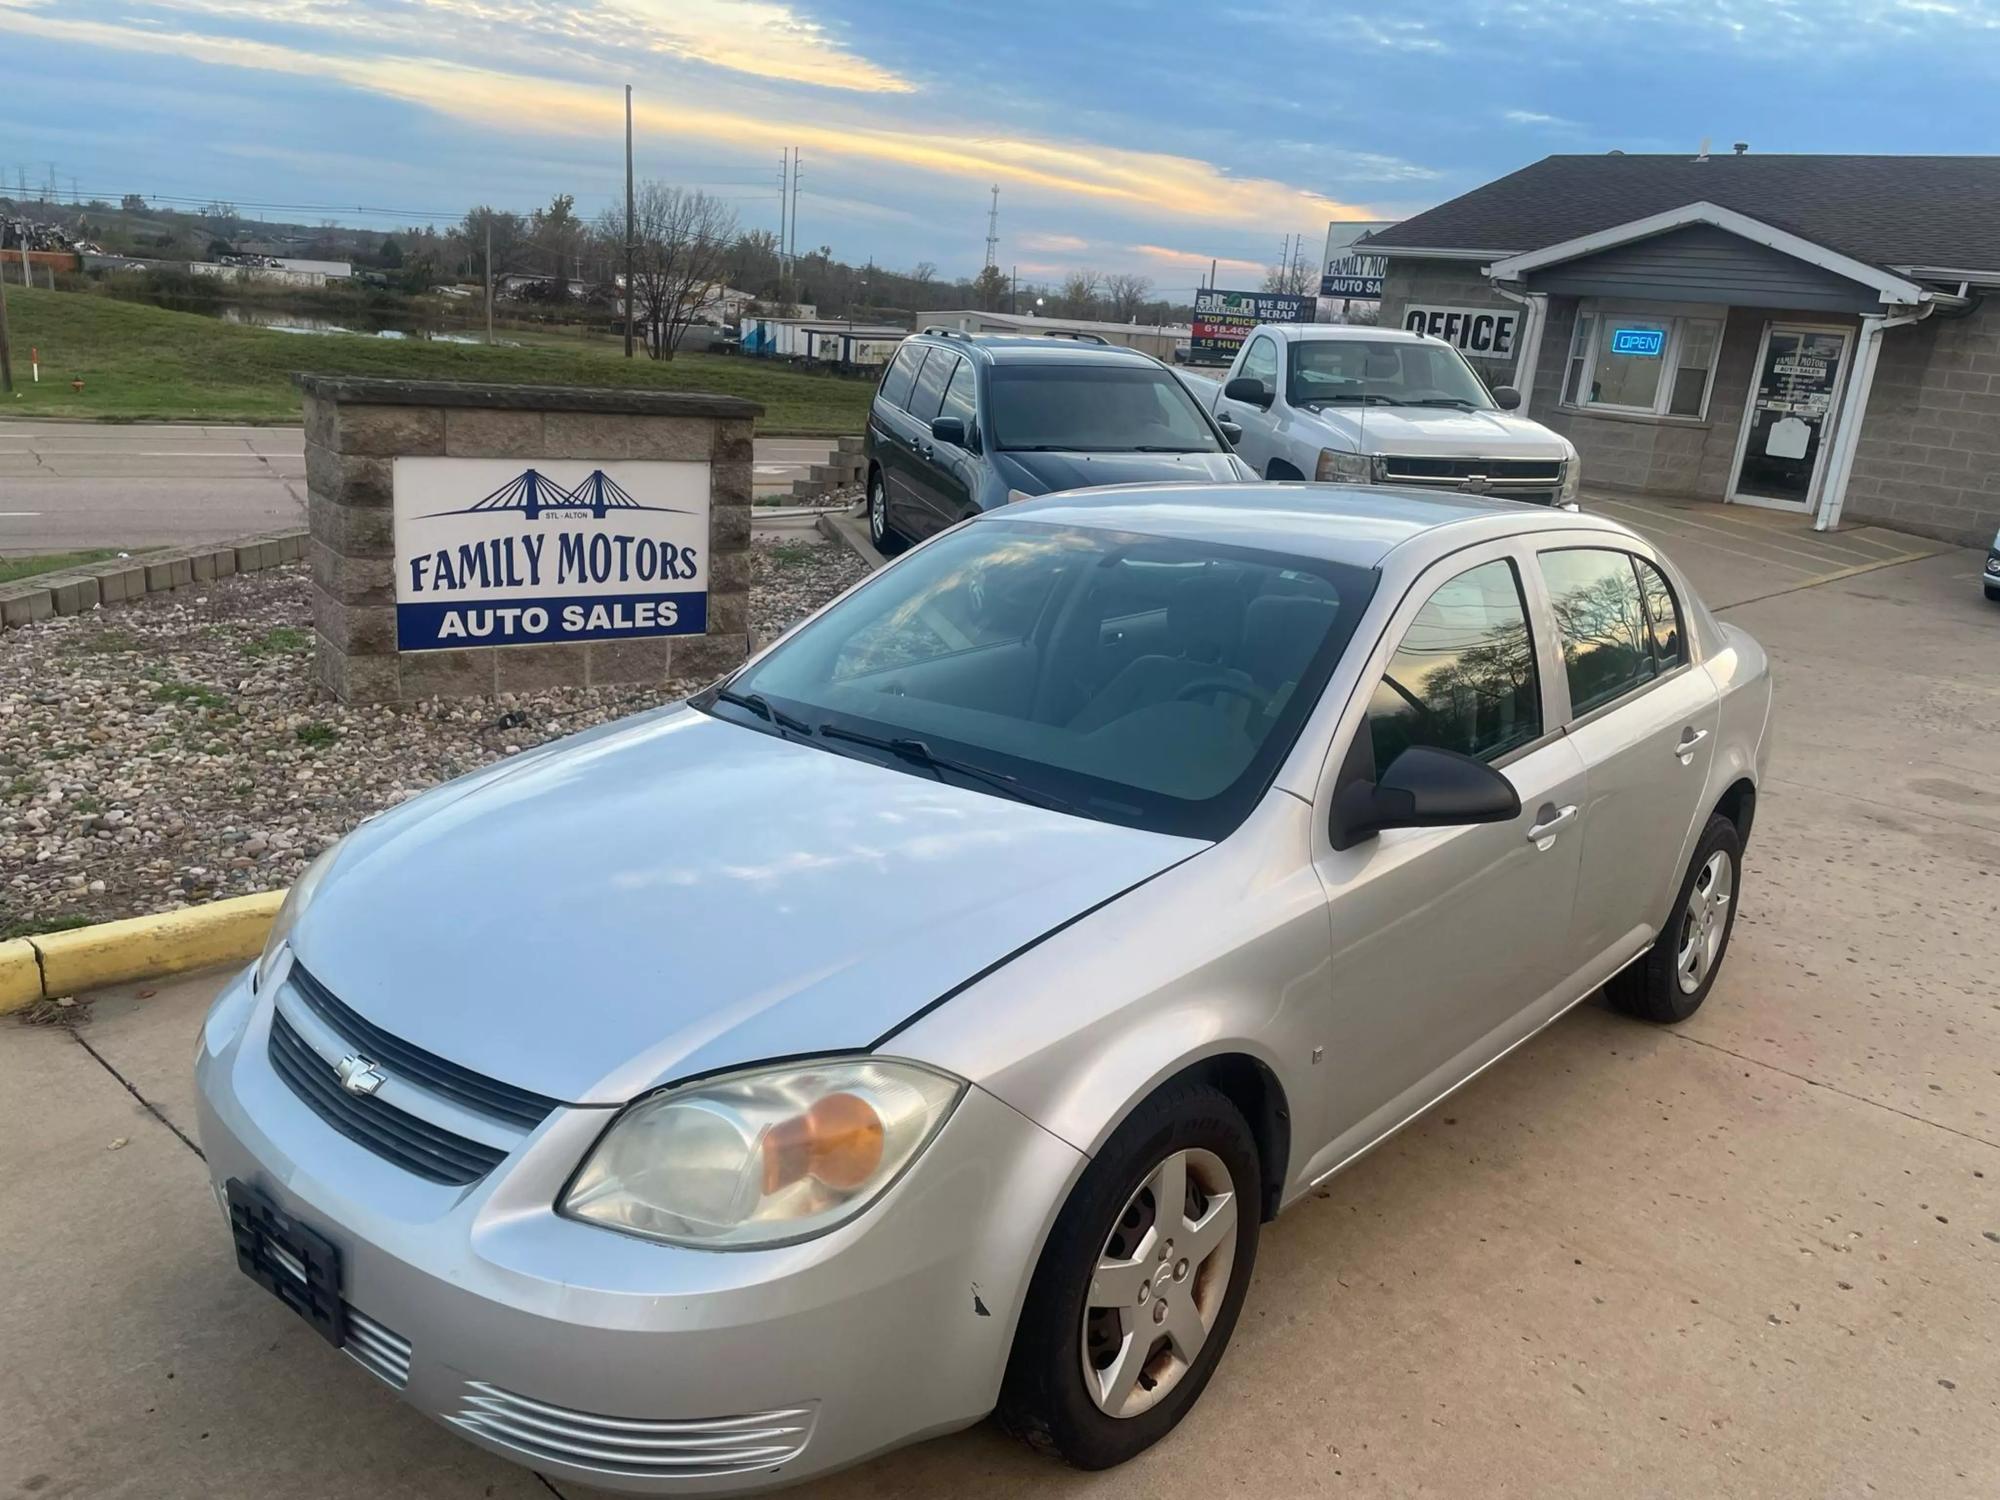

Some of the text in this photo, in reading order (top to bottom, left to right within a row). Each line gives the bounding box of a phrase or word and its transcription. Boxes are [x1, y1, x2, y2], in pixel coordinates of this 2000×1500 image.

[1328, 255, 1364, 275] FAMILY
[1332, 280, 1381, 293] AUTO SA
[1258, 299, 1300, 311] WE BUY
[1259, 309, 1296, 319] SCRAP
[1405, 310, 1514, 352] OFFICE
[1200, 339, 1215, 347] 15
[1619, 335, 1658, 350] OPEN
[545, 512, 558, 520] STL
[564, 511, 588, 520] ALTON
[410, 533, 697, 591] FAMILY MOTORS
[437, 601, 678, 638] AUTO SALES
